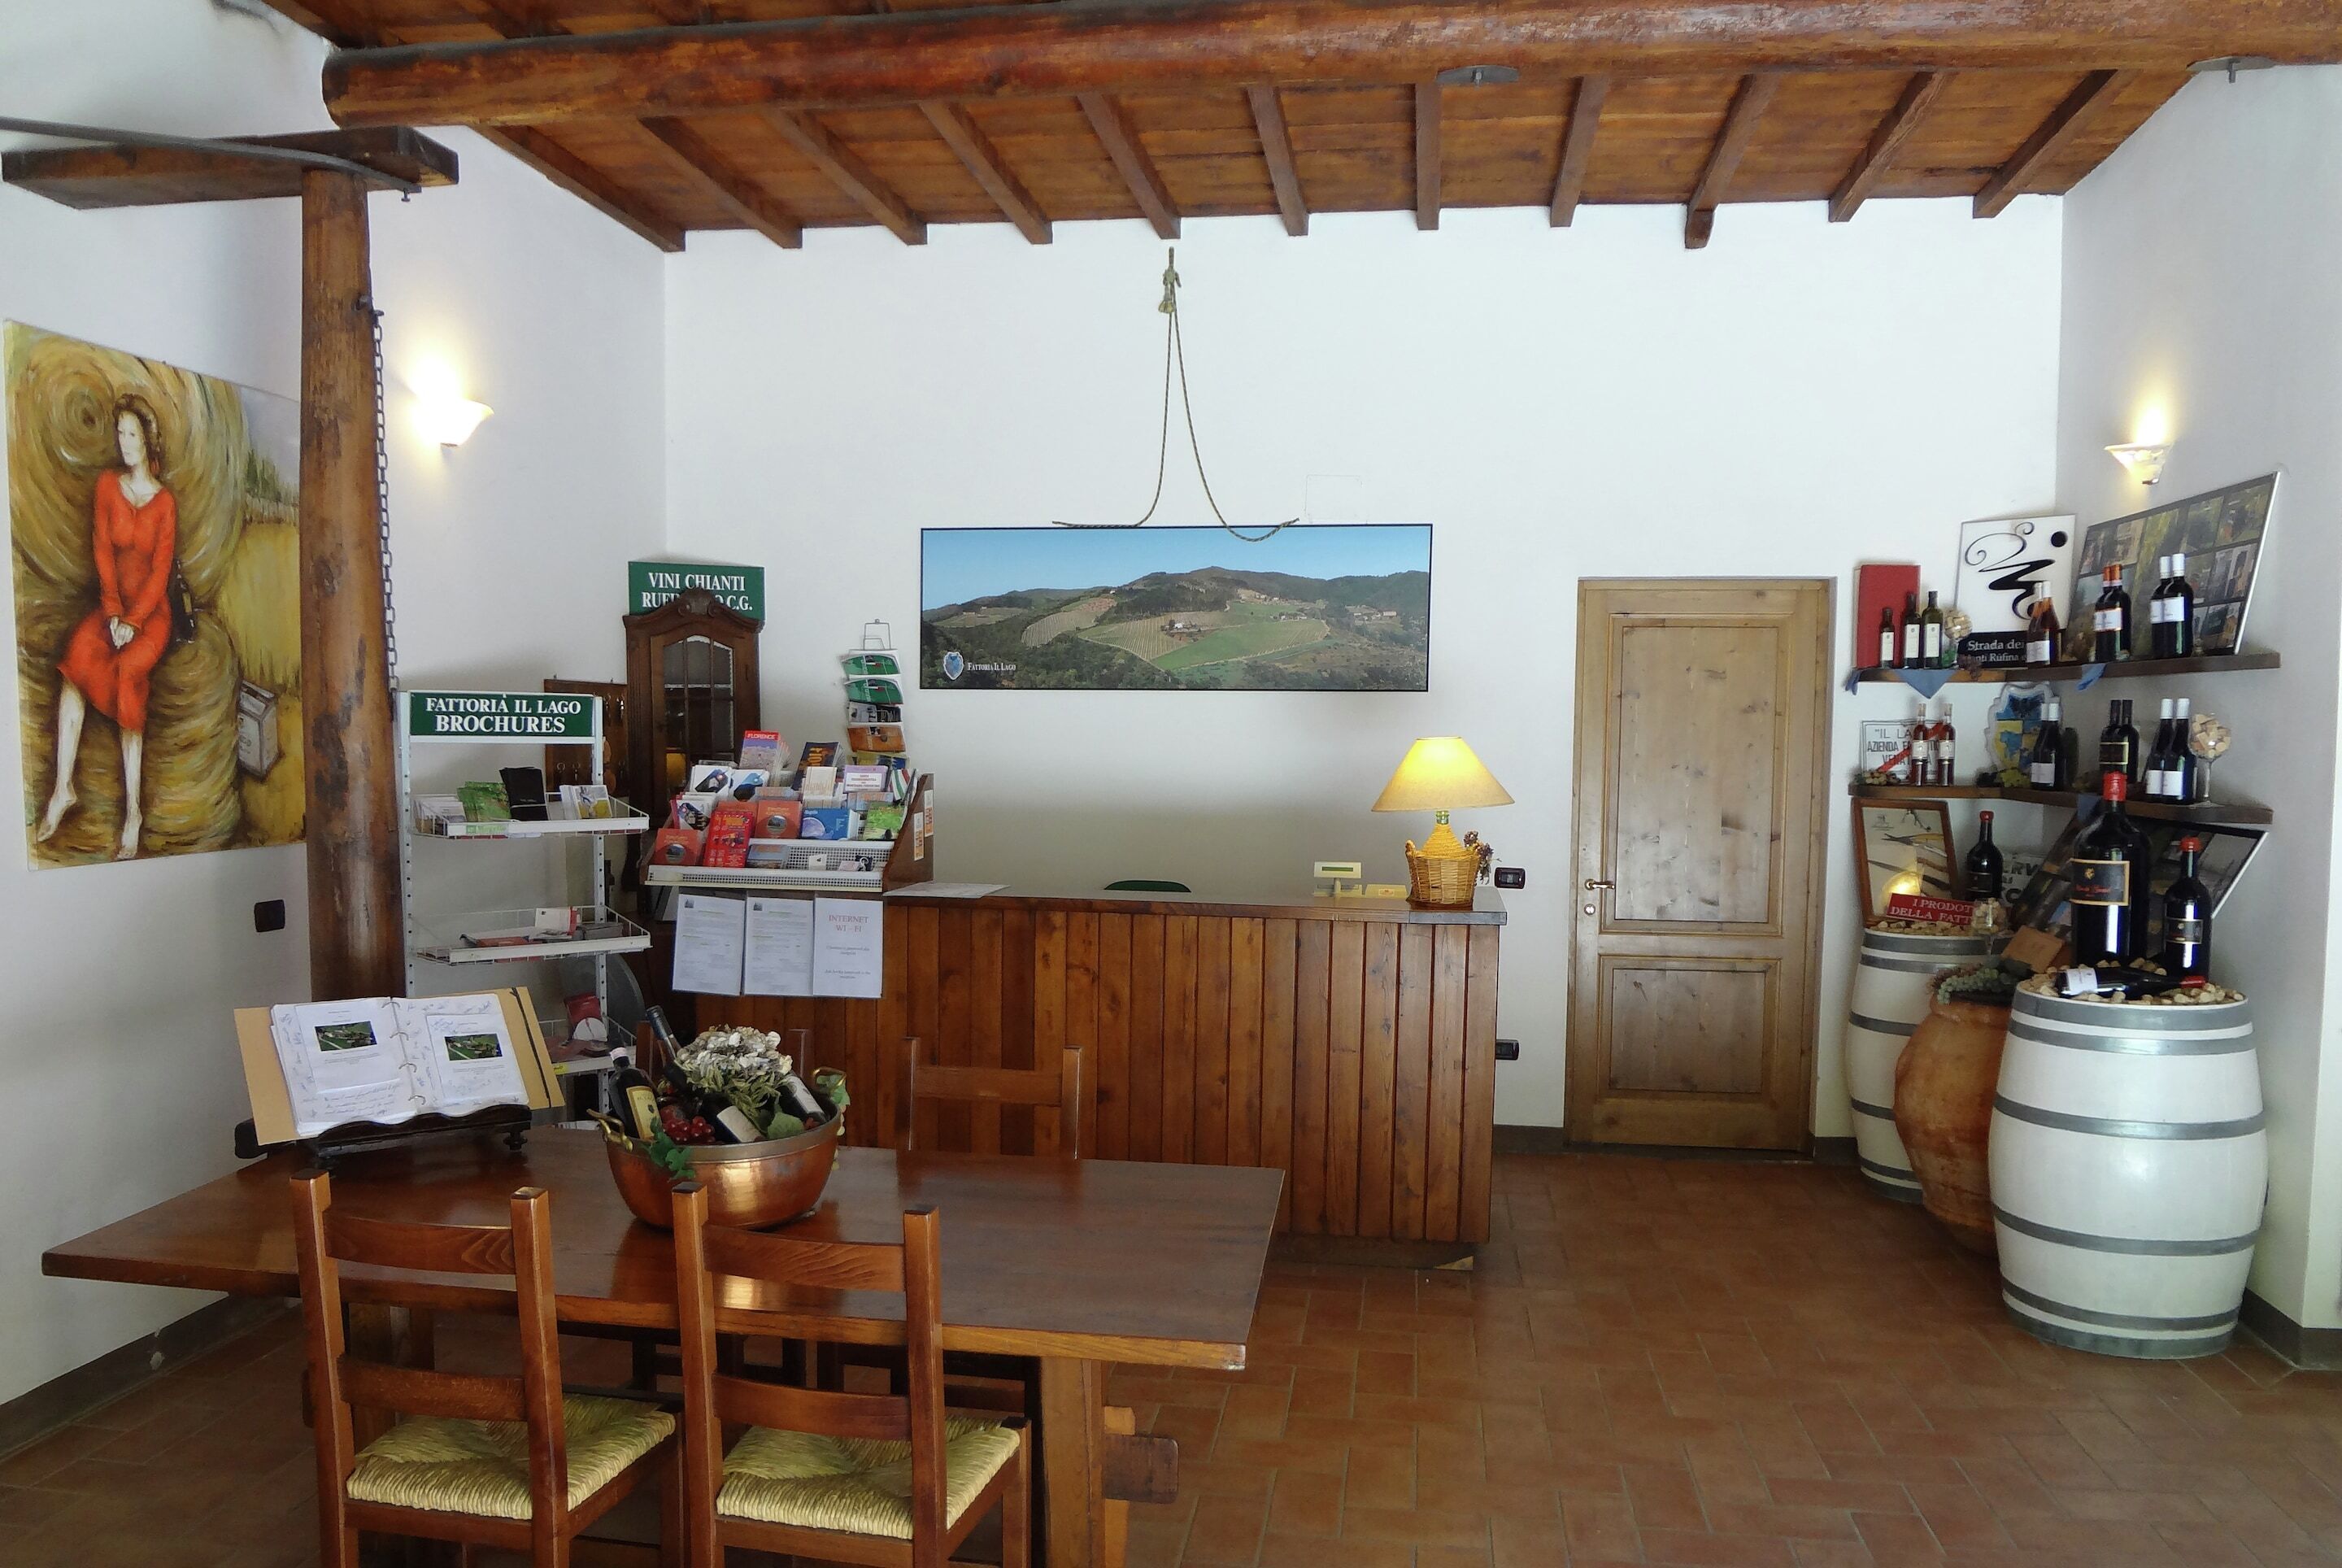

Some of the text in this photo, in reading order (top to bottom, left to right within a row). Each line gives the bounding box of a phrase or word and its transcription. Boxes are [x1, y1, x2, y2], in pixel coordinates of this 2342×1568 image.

[648, 572, 745, 591] VINI CHIANTI
[1968, 639, 2004, 651] Strada
[425, 697, 581, 714] FATTORIA IL LAGO
[435, 714, 566, 734] BROCHURES
[1897, 729, 1913, 739] LA
[1867, 741, 1900, 751] AZIENDA
[1920, 899, 1974, 912] PRODOT
[829, 915, 868, 923] INTERNET
[1891, 907, 1972, 924] DELLA FATT
